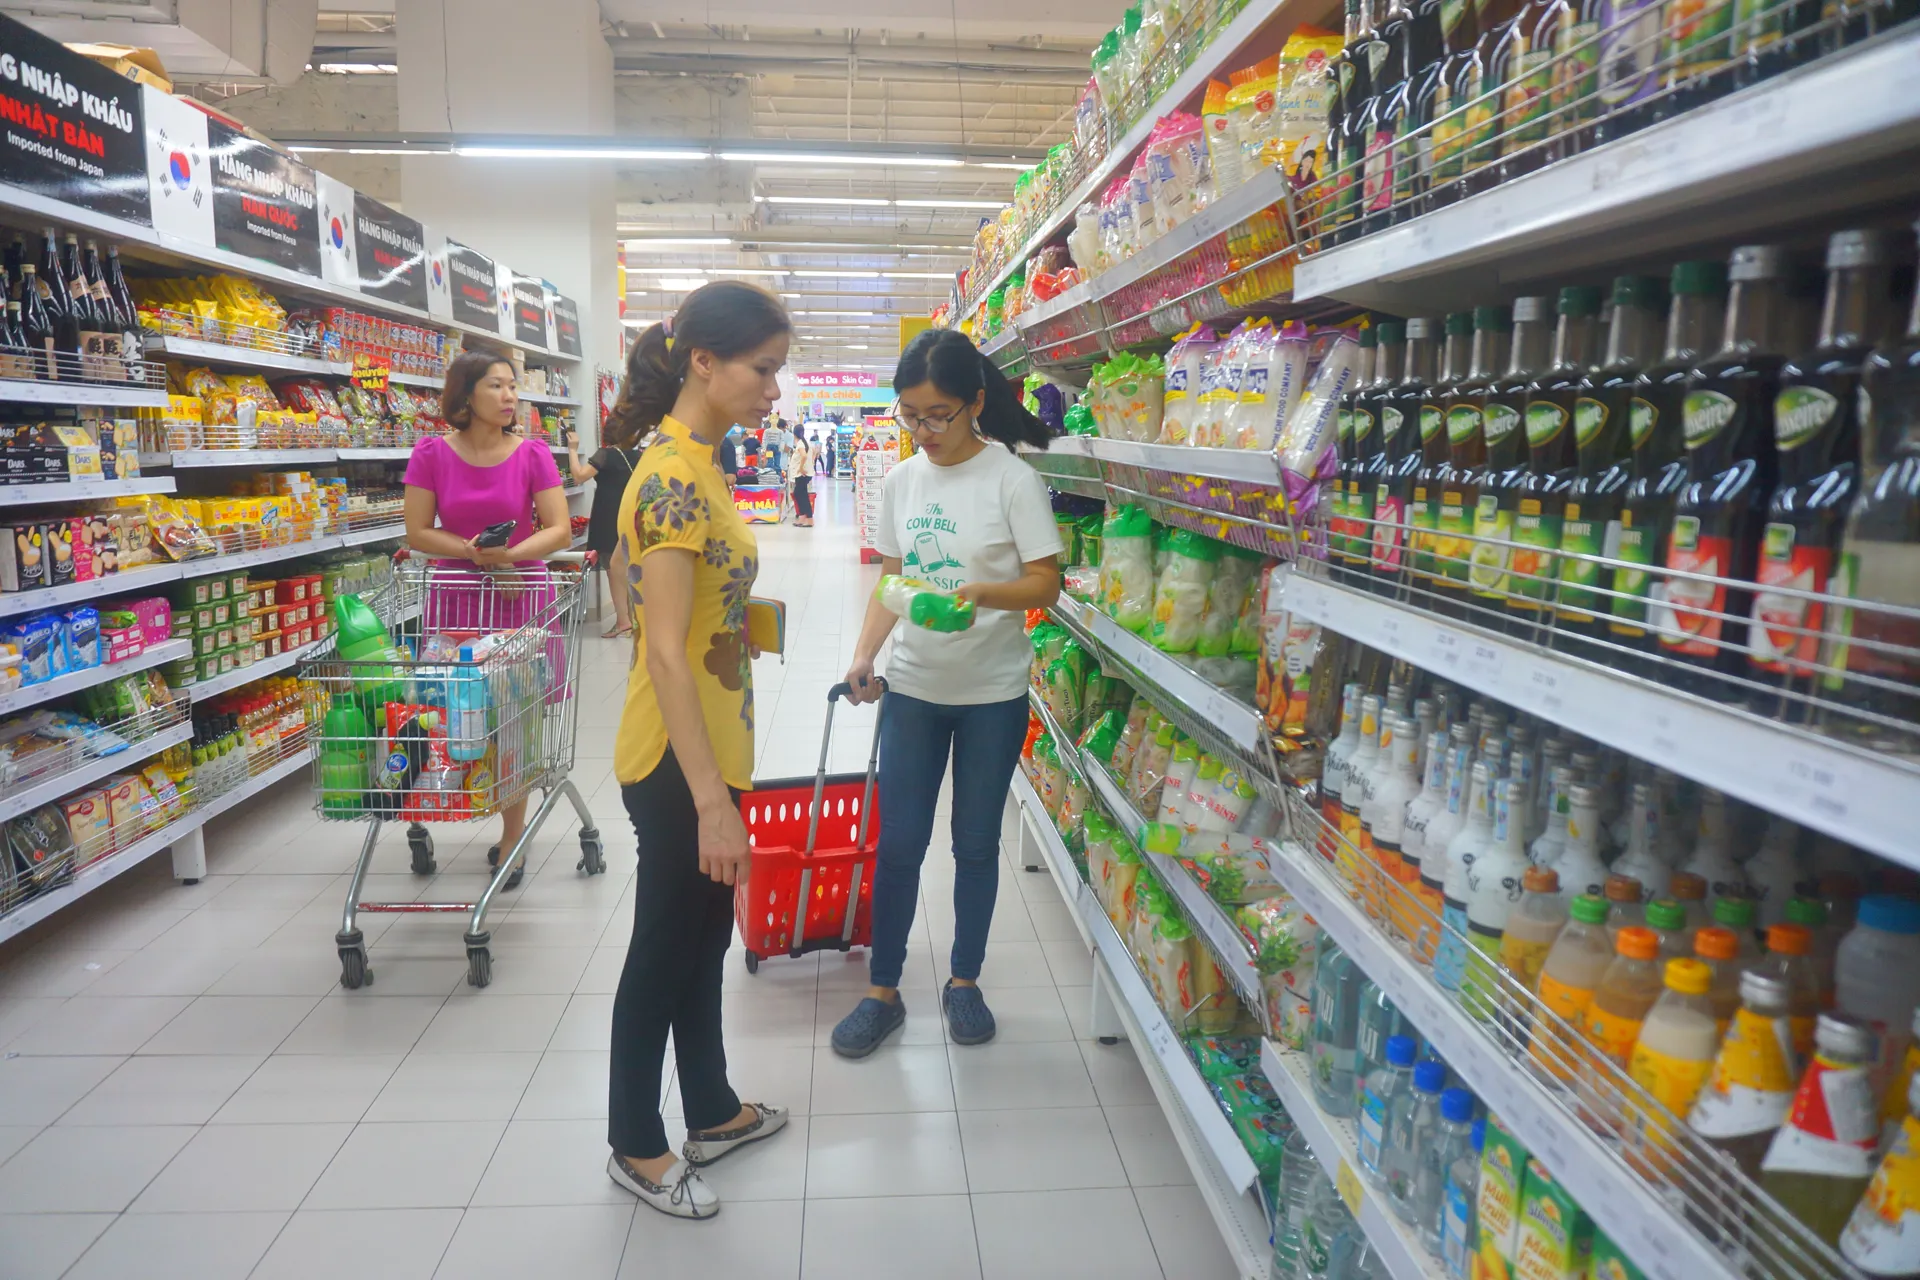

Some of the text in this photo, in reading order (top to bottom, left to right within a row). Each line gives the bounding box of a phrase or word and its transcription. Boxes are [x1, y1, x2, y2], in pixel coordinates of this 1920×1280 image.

[0, 52, 133, 133] G NHẬP KHẨU
[0, 93, 105, 158] NHẬT BẢN
[7, 130, 105, 177] Imported from Japan
[219, 153, 313, 210] HÀNG NHẬP KHẨU
[246, 220, 297, 246] Imported from Korea
[358, 217, 381, 240] HÀNG
[381, 227, 402, 250] NHẬP
[352, 365, 389, 378] KHUYẾN
[825, 376, 838, 384] Da
[842, 376, 857, 384] Skin
[1280, 362, 1293, 398] COMPANY
[361, 378, 384, 389] MÃI
[1329, 366, 1352, 402] COMPANY
[1276, 399, 1288, 417] FOOD
[1323, 400, 1336, 420] FOOD
[734, 498, 776, 511] YẾN MÃI
[926, 502, 944, 515] The
[906, 517, 957, 534] COW BELL
[24, 628, 50, 645] OREO
